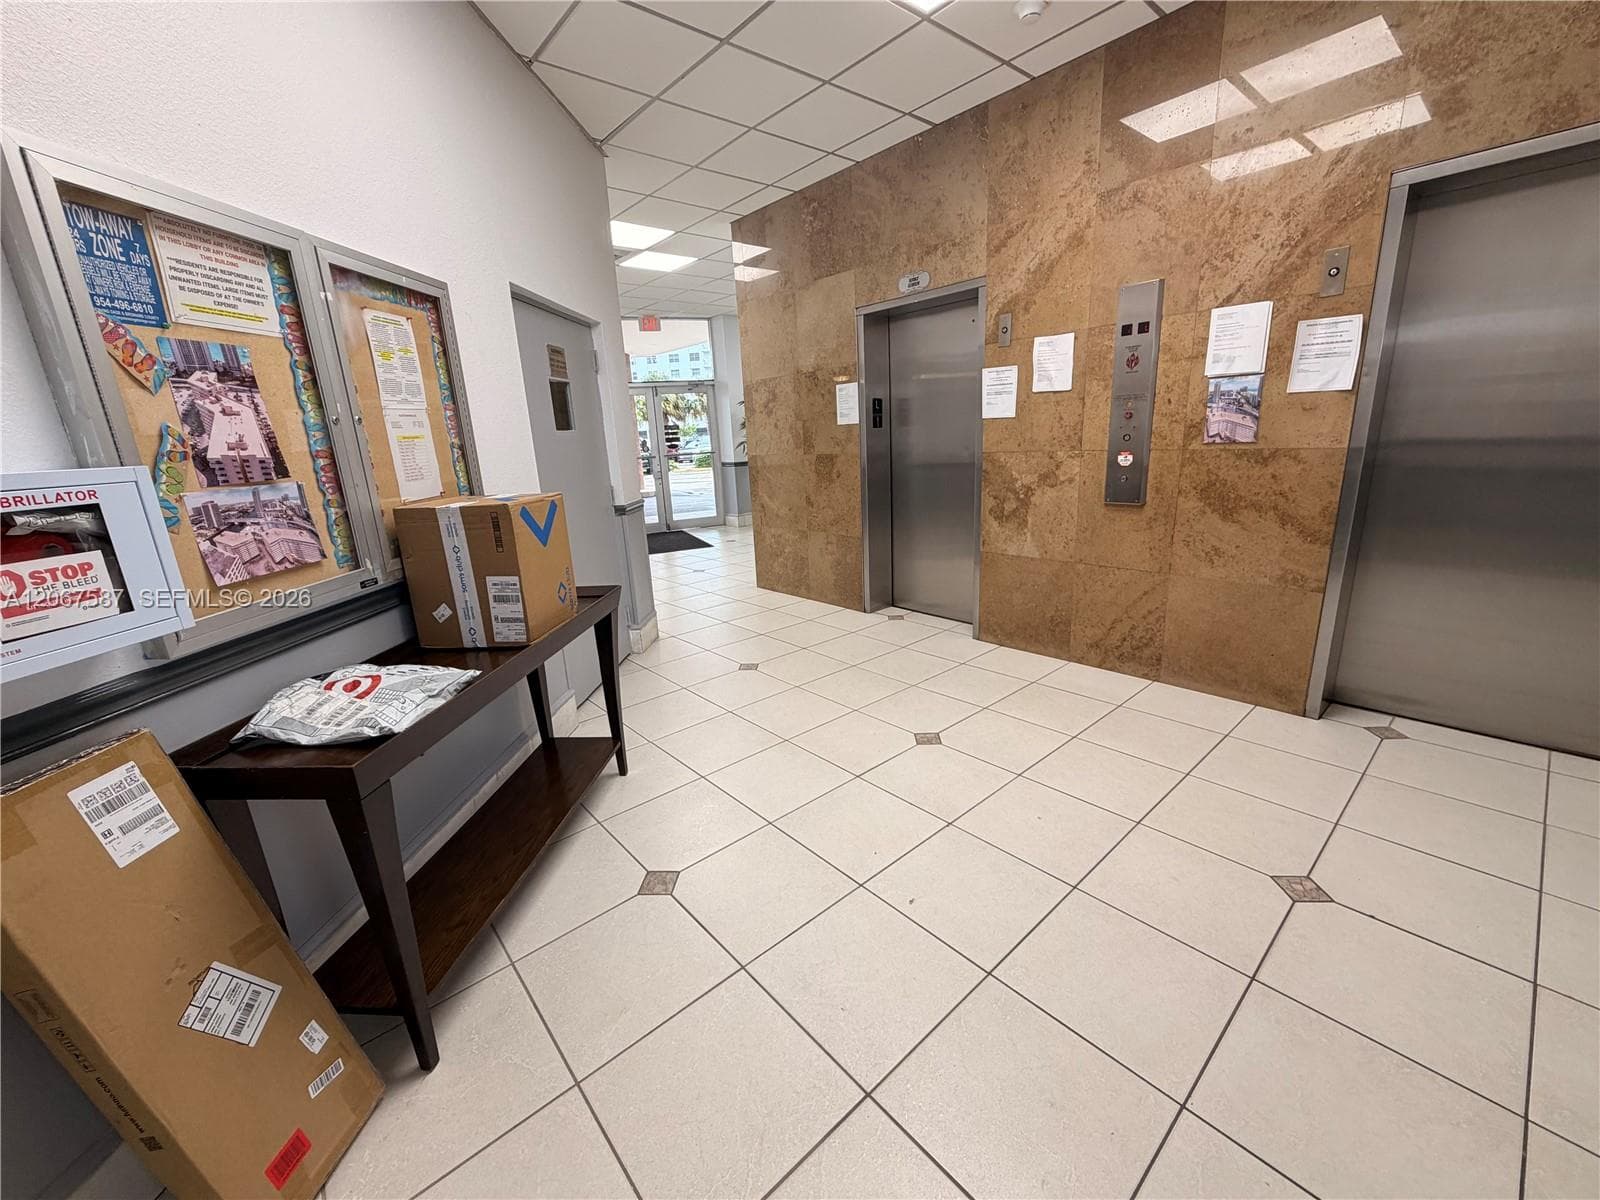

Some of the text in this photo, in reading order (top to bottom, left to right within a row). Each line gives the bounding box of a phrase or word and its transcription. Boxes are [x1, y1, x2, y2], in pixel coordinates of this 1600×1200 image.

[62, 201, 135, 241] TOW-AWAY
[88, 231, 126, 261] ZONE
[133, 242, 141, 252] 7
[166, 235, 182, 245] THIS
[128, 250, 151, 267] DAYS
[199, 253, 239, 268] THIS BUILDING
[168, 265, 199, 277] PROPERLY
[199, 272, 233, 284] DISCARDING
[219, 268, 253, 281] RESPONSIBLE
[168, 274, 201, 286] UNWANTED
[221, 285, 239, 293] LARGE
[239, 289, 255, 297] ITEMS
[186, 286, 215, 296] DISPOSED
[92, 295, 154, 314] 954-496-6810
[0, 489, 99, 508] BRILLATOR
[29, 561, 94, 586] STOP
[33, 576, 99, 595] THE BLEED
